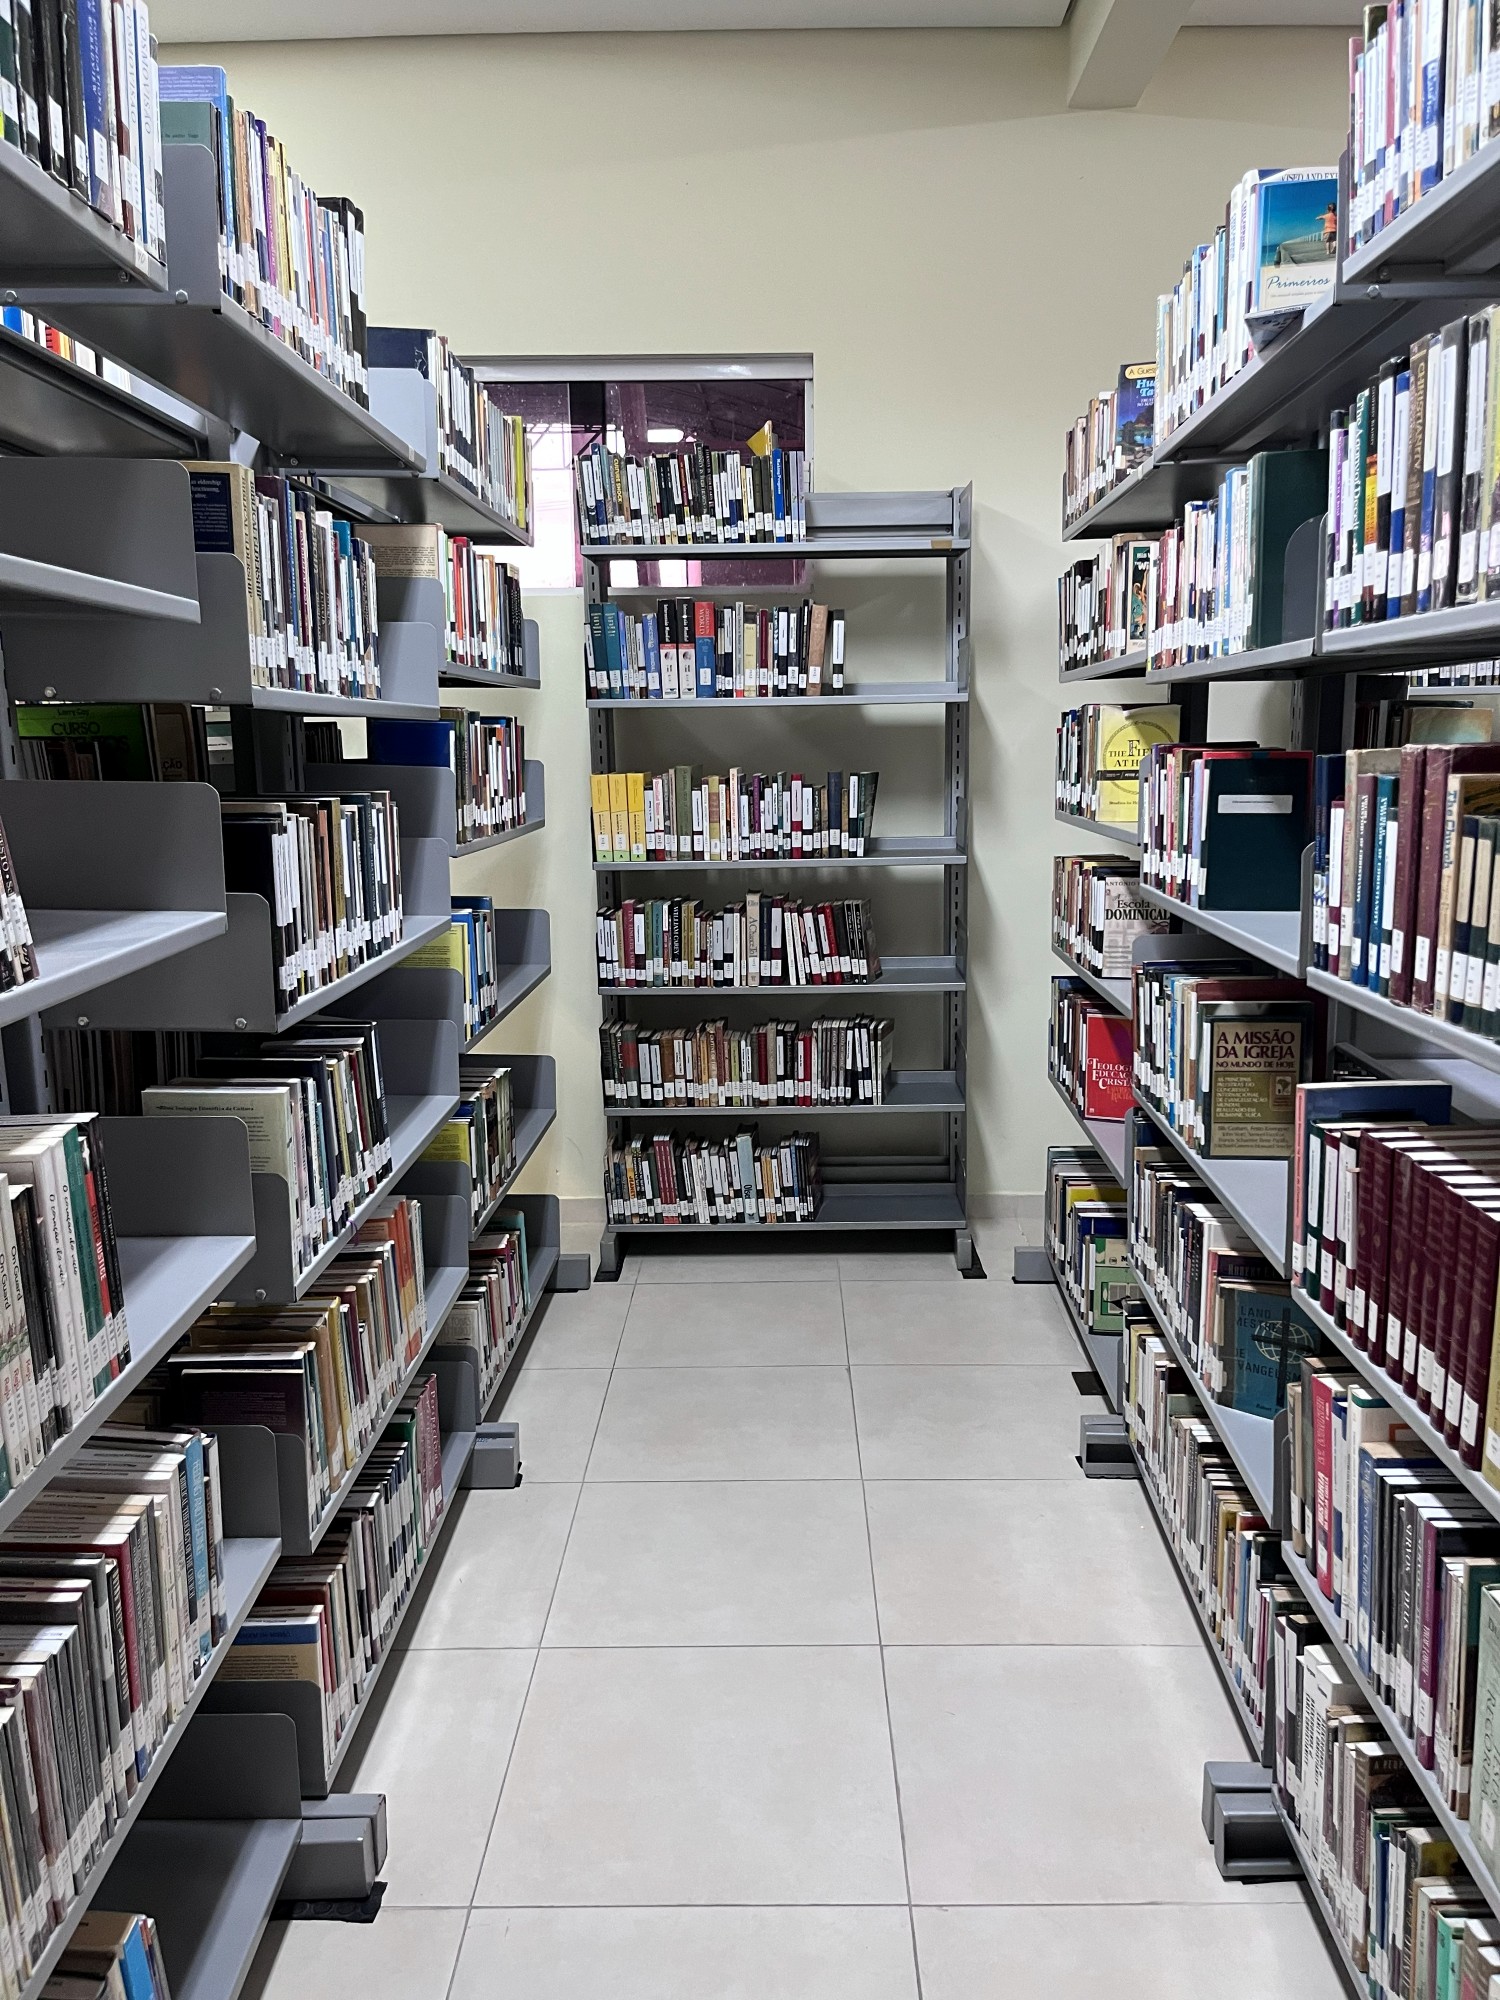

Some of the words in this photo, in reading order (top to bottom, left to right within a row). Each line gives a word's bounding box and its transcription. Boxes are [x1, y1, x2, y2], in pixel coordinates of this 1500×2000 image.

[139, 15, 152, 135] COSMOVISÃO
[1267, 275, 1331, 290] Primeiros
[1135, 379, 1155, 388] Hu
[252, 540, 262, 600] ELDERSHIP
[51, 721, 102, 736] CURSO
[1446, 791, 1457, 817] The
[1442, 820, 1455, 869] Church
[1105, 908, 1171, 921] DOMINICAL
[1117, 899, 1151, 909] Escola
[1217, 1031, 1229, 1044] A
[1233, 1028, 1295, 1045] MISSÃO
[1216, 1045, 1239, 1058] DA
[1244, 1045, 1295, 1061] IGREJA
[1087, 1057, 1133, 1071] TEOLOGI
[13, 1265, 23, 1301] Guard
[1404, 1522, 1413, 1572] SERVOS
[1402, 1590, 1412, 1630] DEUS
[1481, 1690, 1497, 1800] RECORDA
